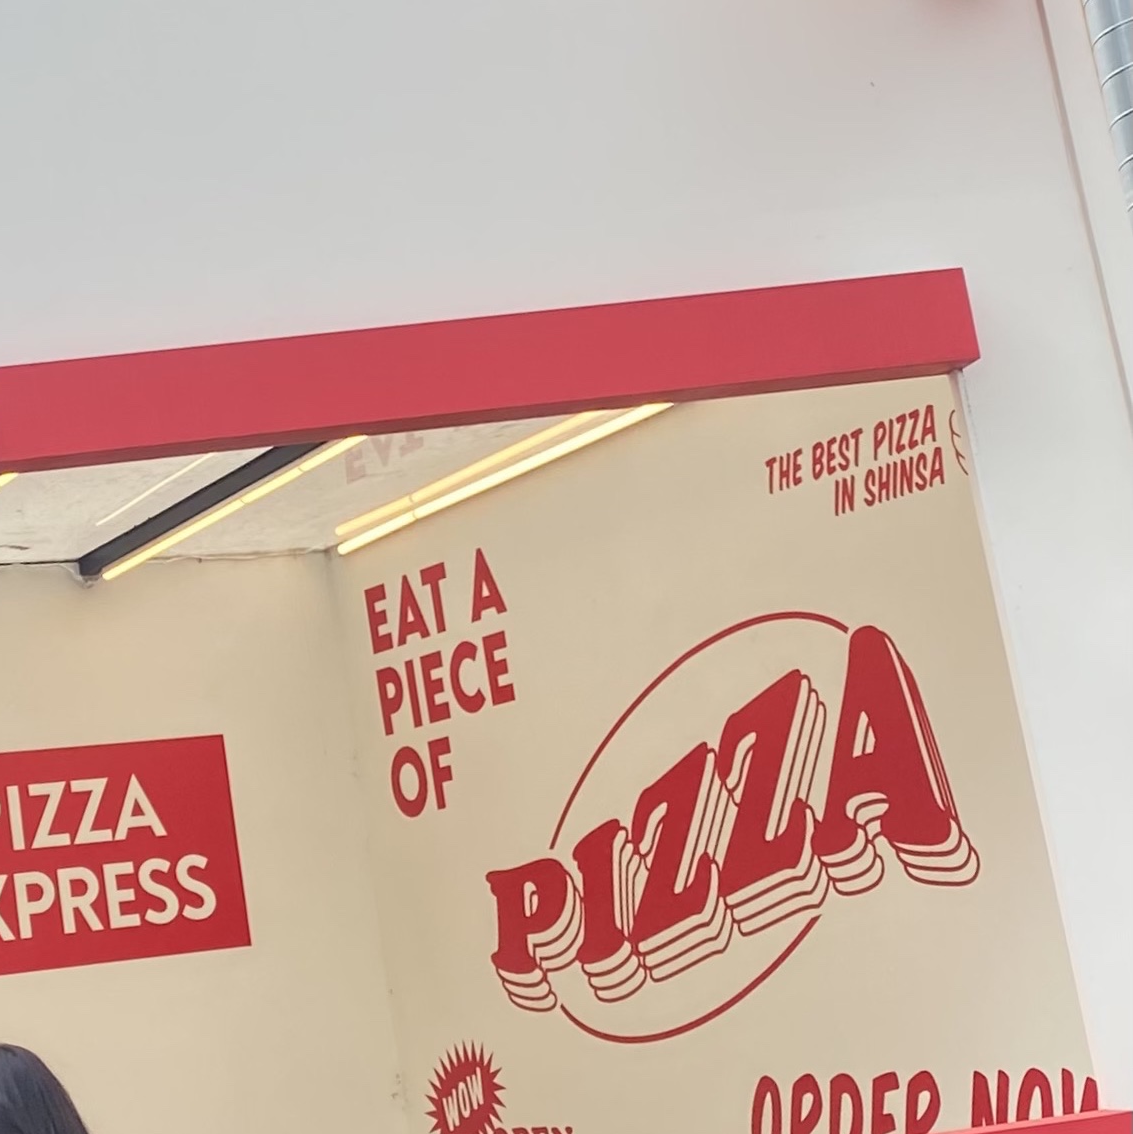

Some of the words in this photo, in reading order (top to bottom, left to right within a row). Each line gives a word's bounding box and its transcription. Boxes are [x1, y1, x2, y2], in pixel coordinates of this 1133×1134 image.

[764, 448, 803, 495] THE
[811, 428, 864, 481] BEST
[873, 404, 937, 462] PIZZA
[834, 475, 856, 517] IN
[863, 446, 945, 508] SHINSA
[364, 561, 447, 655] EAT
[470, 547, 508, 623] A
[376, 630, 516, 736] PIECE
[390, 735, 454, 818] OF
[485, 625, 980, 1013] PIZZA
[442, 1066, 485, 1133] WOW
